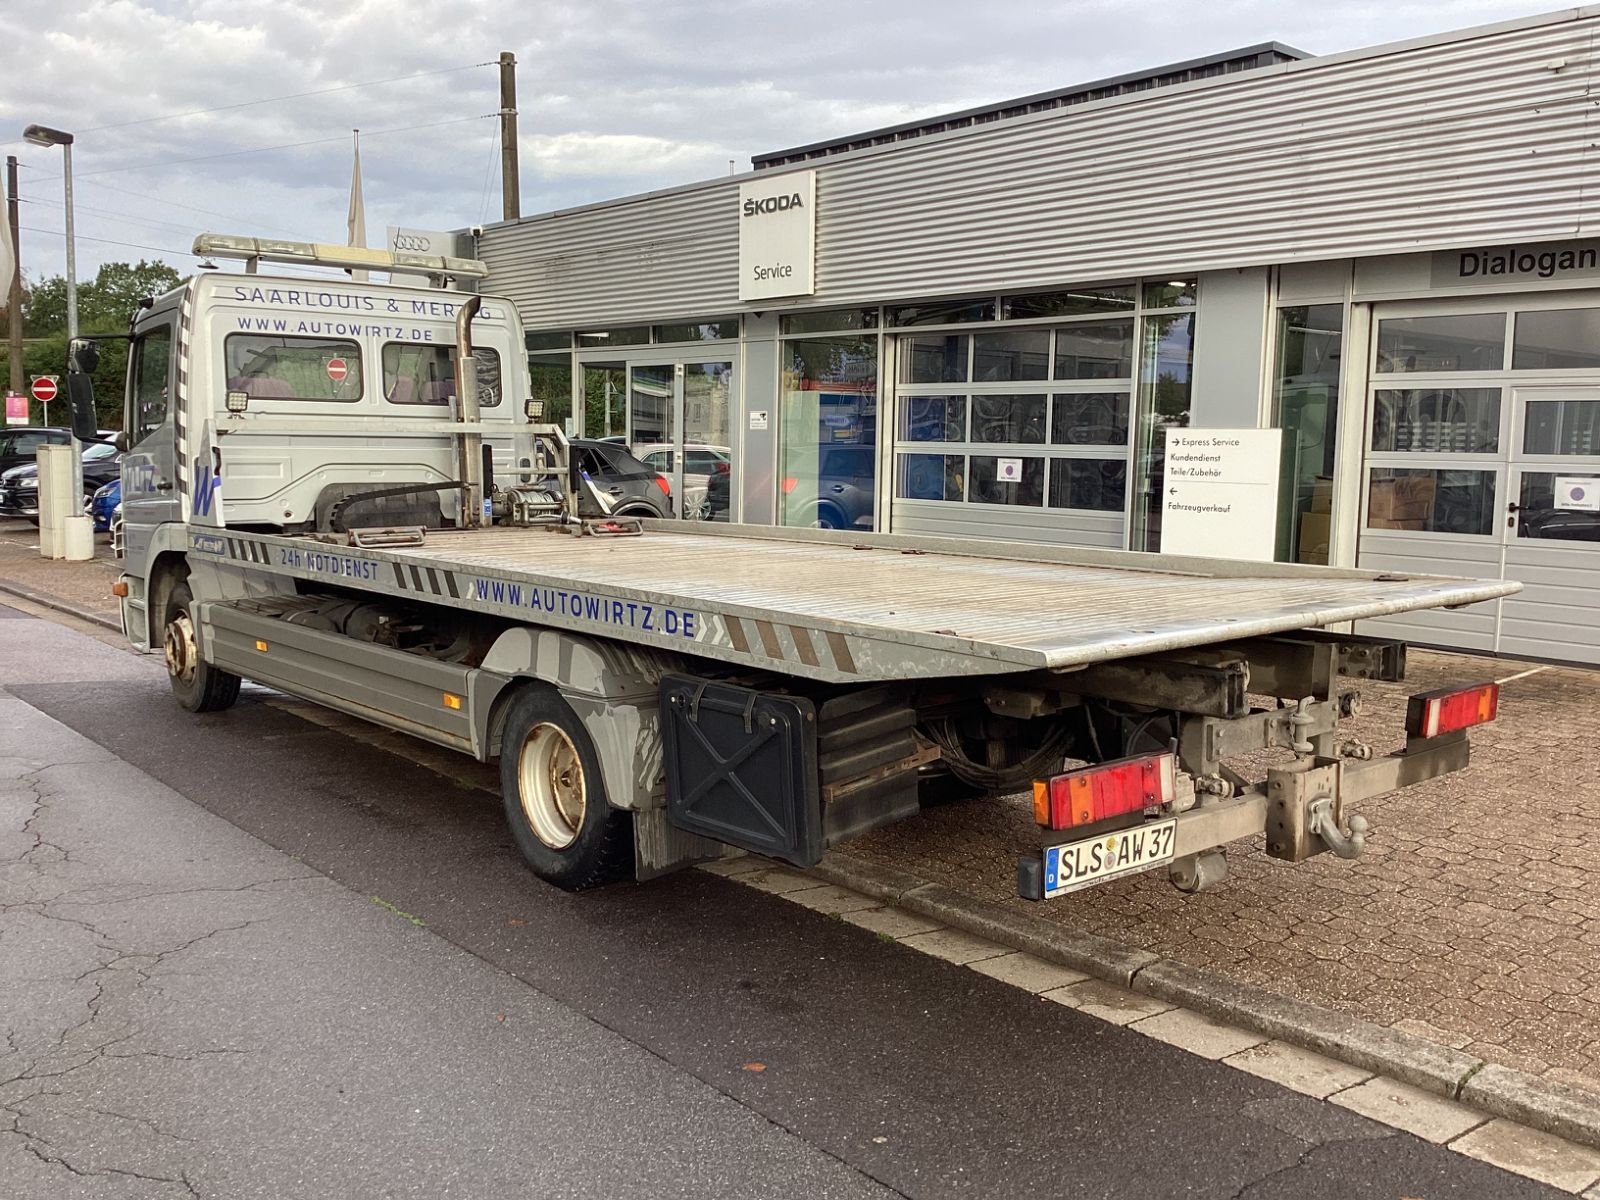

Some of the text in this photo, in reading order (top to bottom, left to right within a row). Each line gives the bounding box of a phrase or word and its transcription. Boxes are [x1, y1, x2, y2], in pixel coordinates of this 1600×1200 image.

[743, 192, 803, 217] ŠKODA
[753, 262, 792, 281] Service
[1459, 248, 1597, 278] Dialogan
[234, 286, 491, 320] SAARLOUIS & MERG
[237, 317, 433, 341] WWW.AUTOWIRTZ.DE
[1181, 437, 1240, 447] Express Service
[1170, 453, 1221, 462] Kundendienst
[1170, 467, 1222, 477] Teile/Zubehör
[1168, 501, 1231, 513] Fahrzeugverkauf
[281, 548, 378, 580] 24h NOTDIENST
[476, 578, 695, 638] WWW.AUTOWIRTZ.DE
[1060, 842, 1103, 881] SLS
[1117, 831, 1145, 866] AW
[1148, 825, 1174, 858] 37
